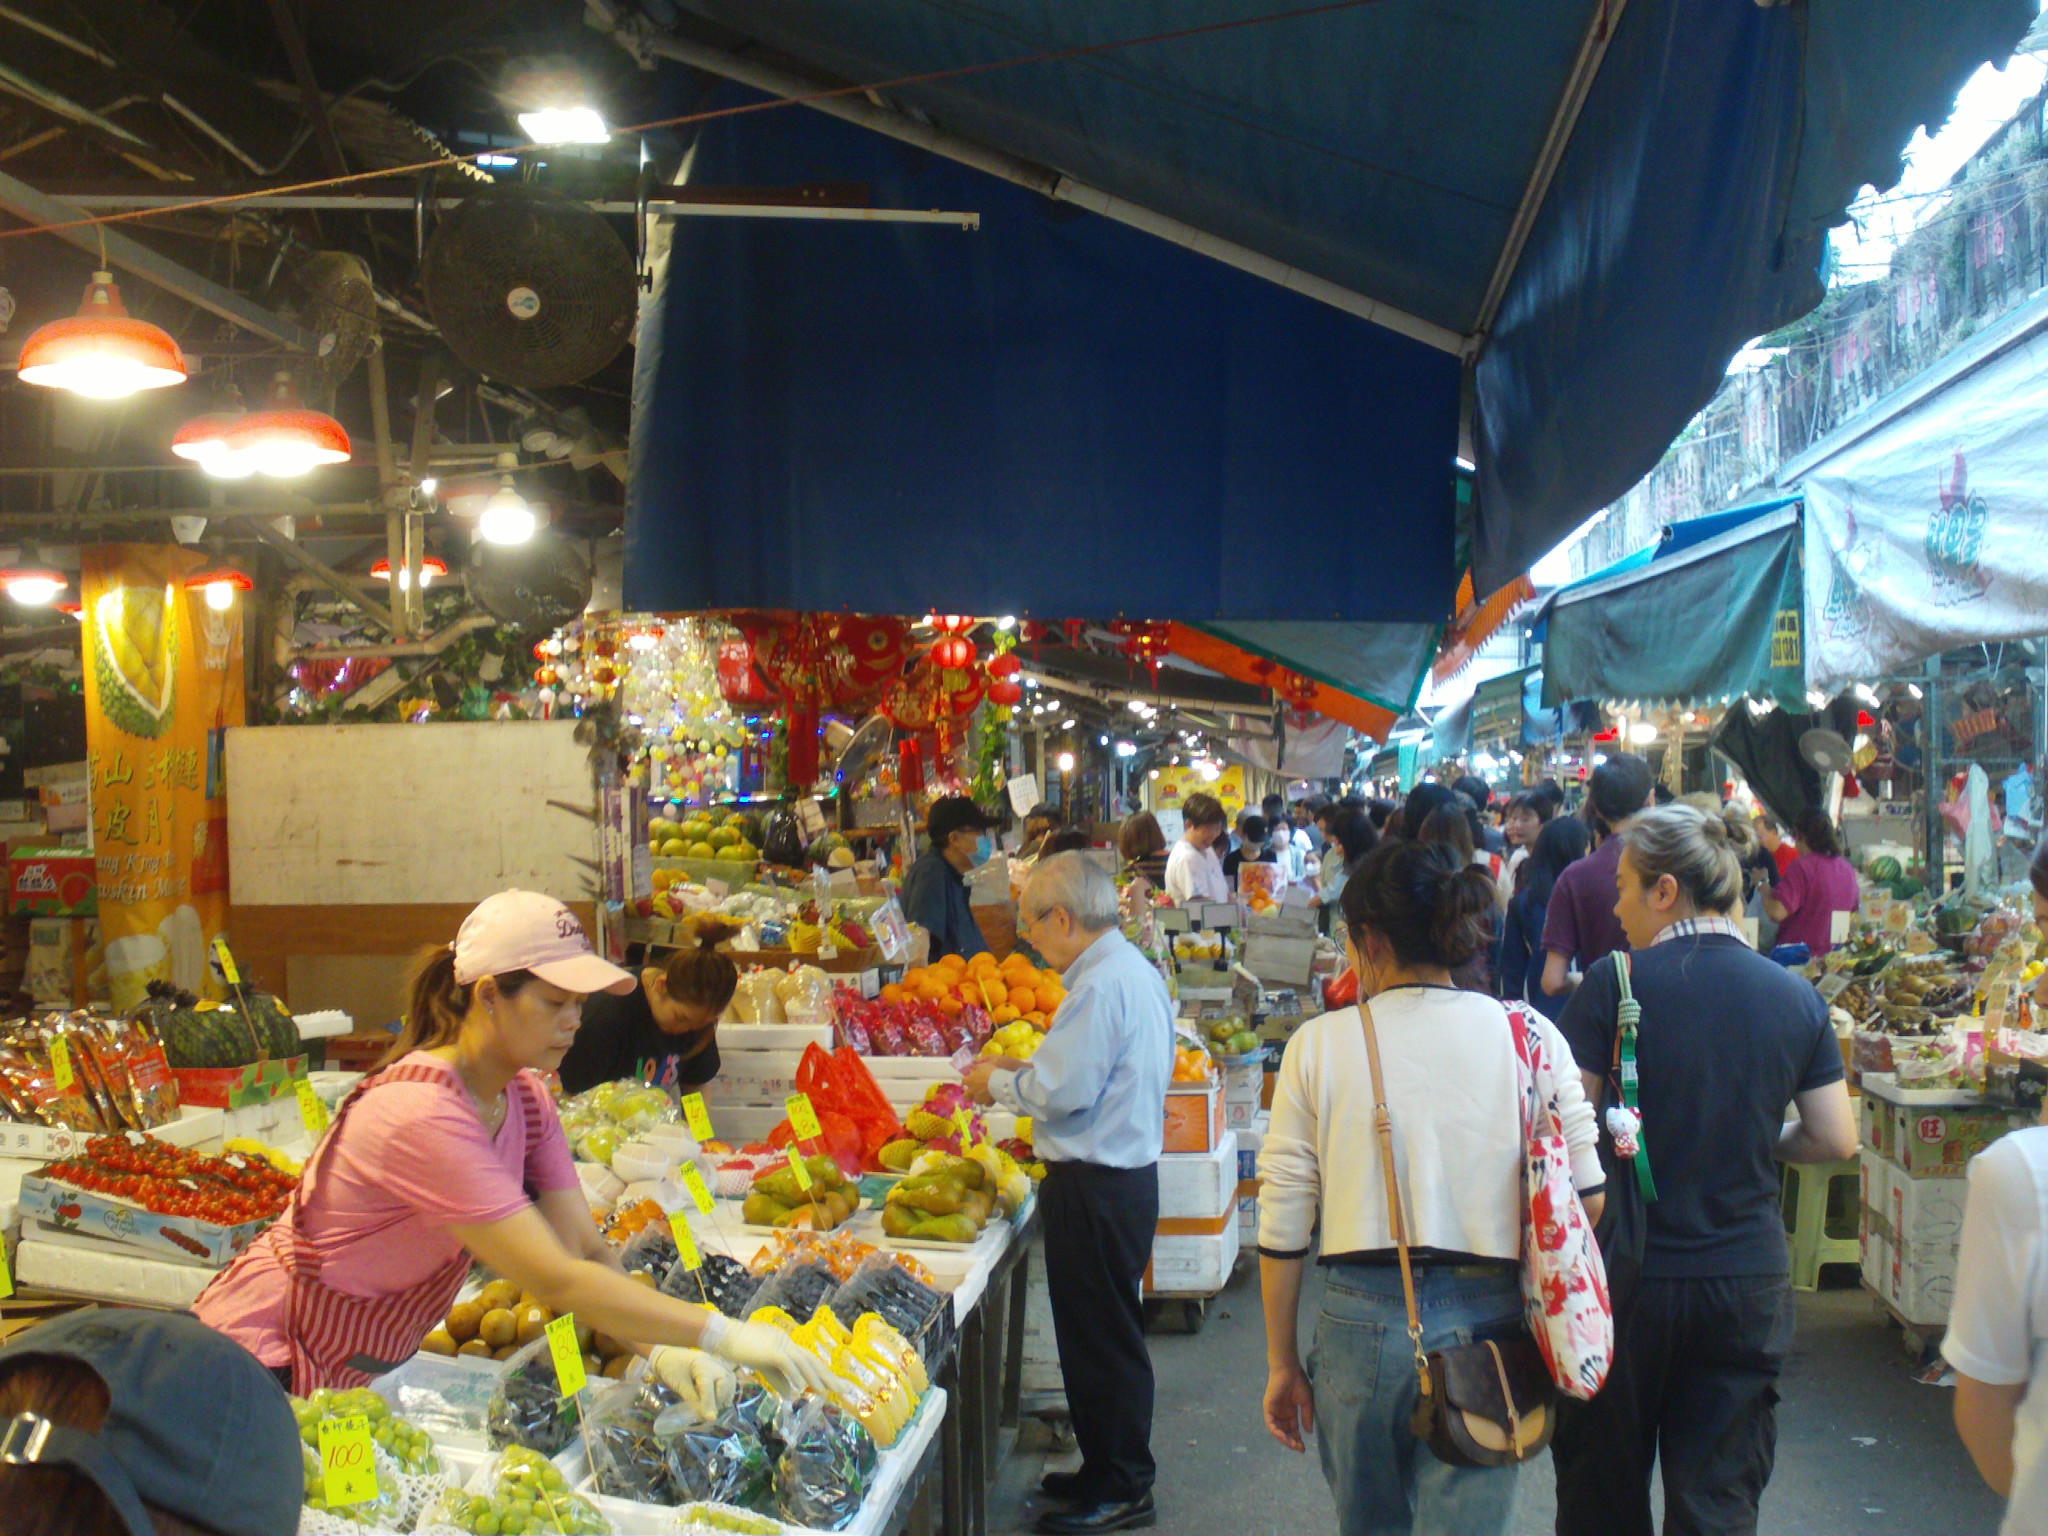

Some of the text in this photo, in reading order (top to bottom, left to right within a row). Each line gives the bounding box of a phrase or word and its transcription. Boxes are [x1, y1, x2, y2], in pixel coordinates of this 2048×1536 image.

[1920, 1118, 1943, 1139] 旺
[556, 1330, 576, 1361] 80
[328, 1441, 364, 1470] 100
